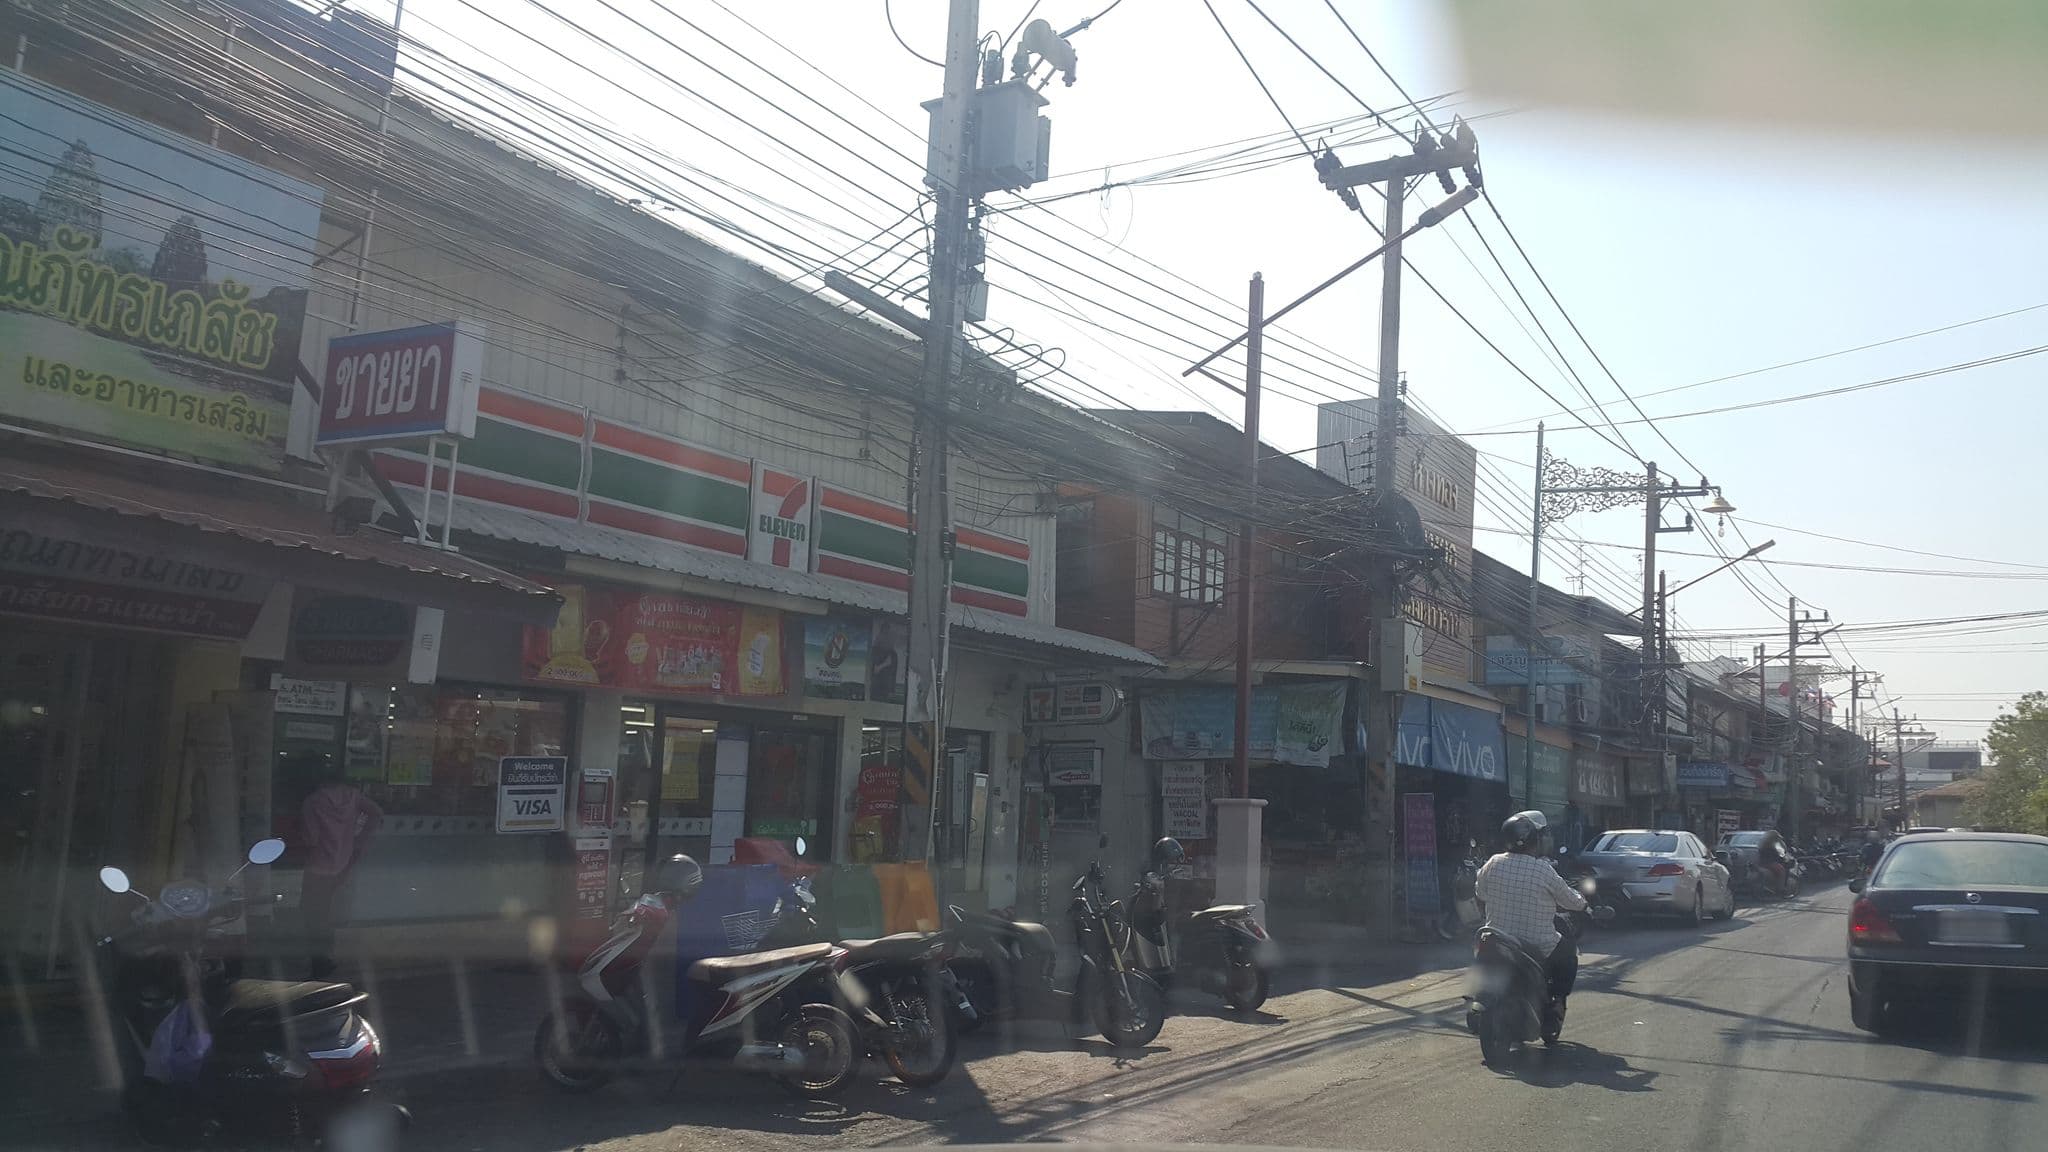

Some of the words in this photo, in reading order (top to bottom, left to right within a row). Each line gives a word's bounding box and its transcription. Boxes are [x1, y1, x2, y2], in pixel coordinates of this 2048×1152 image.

[24, 356, 267, 438] และอาหารเสริม
[336, 344, 441, 420] ขายยา
[513, 761, 555, 772] Welcome
[1446, 729, 1496, 780] vivo
[512, 799, 552, 815] VISA
